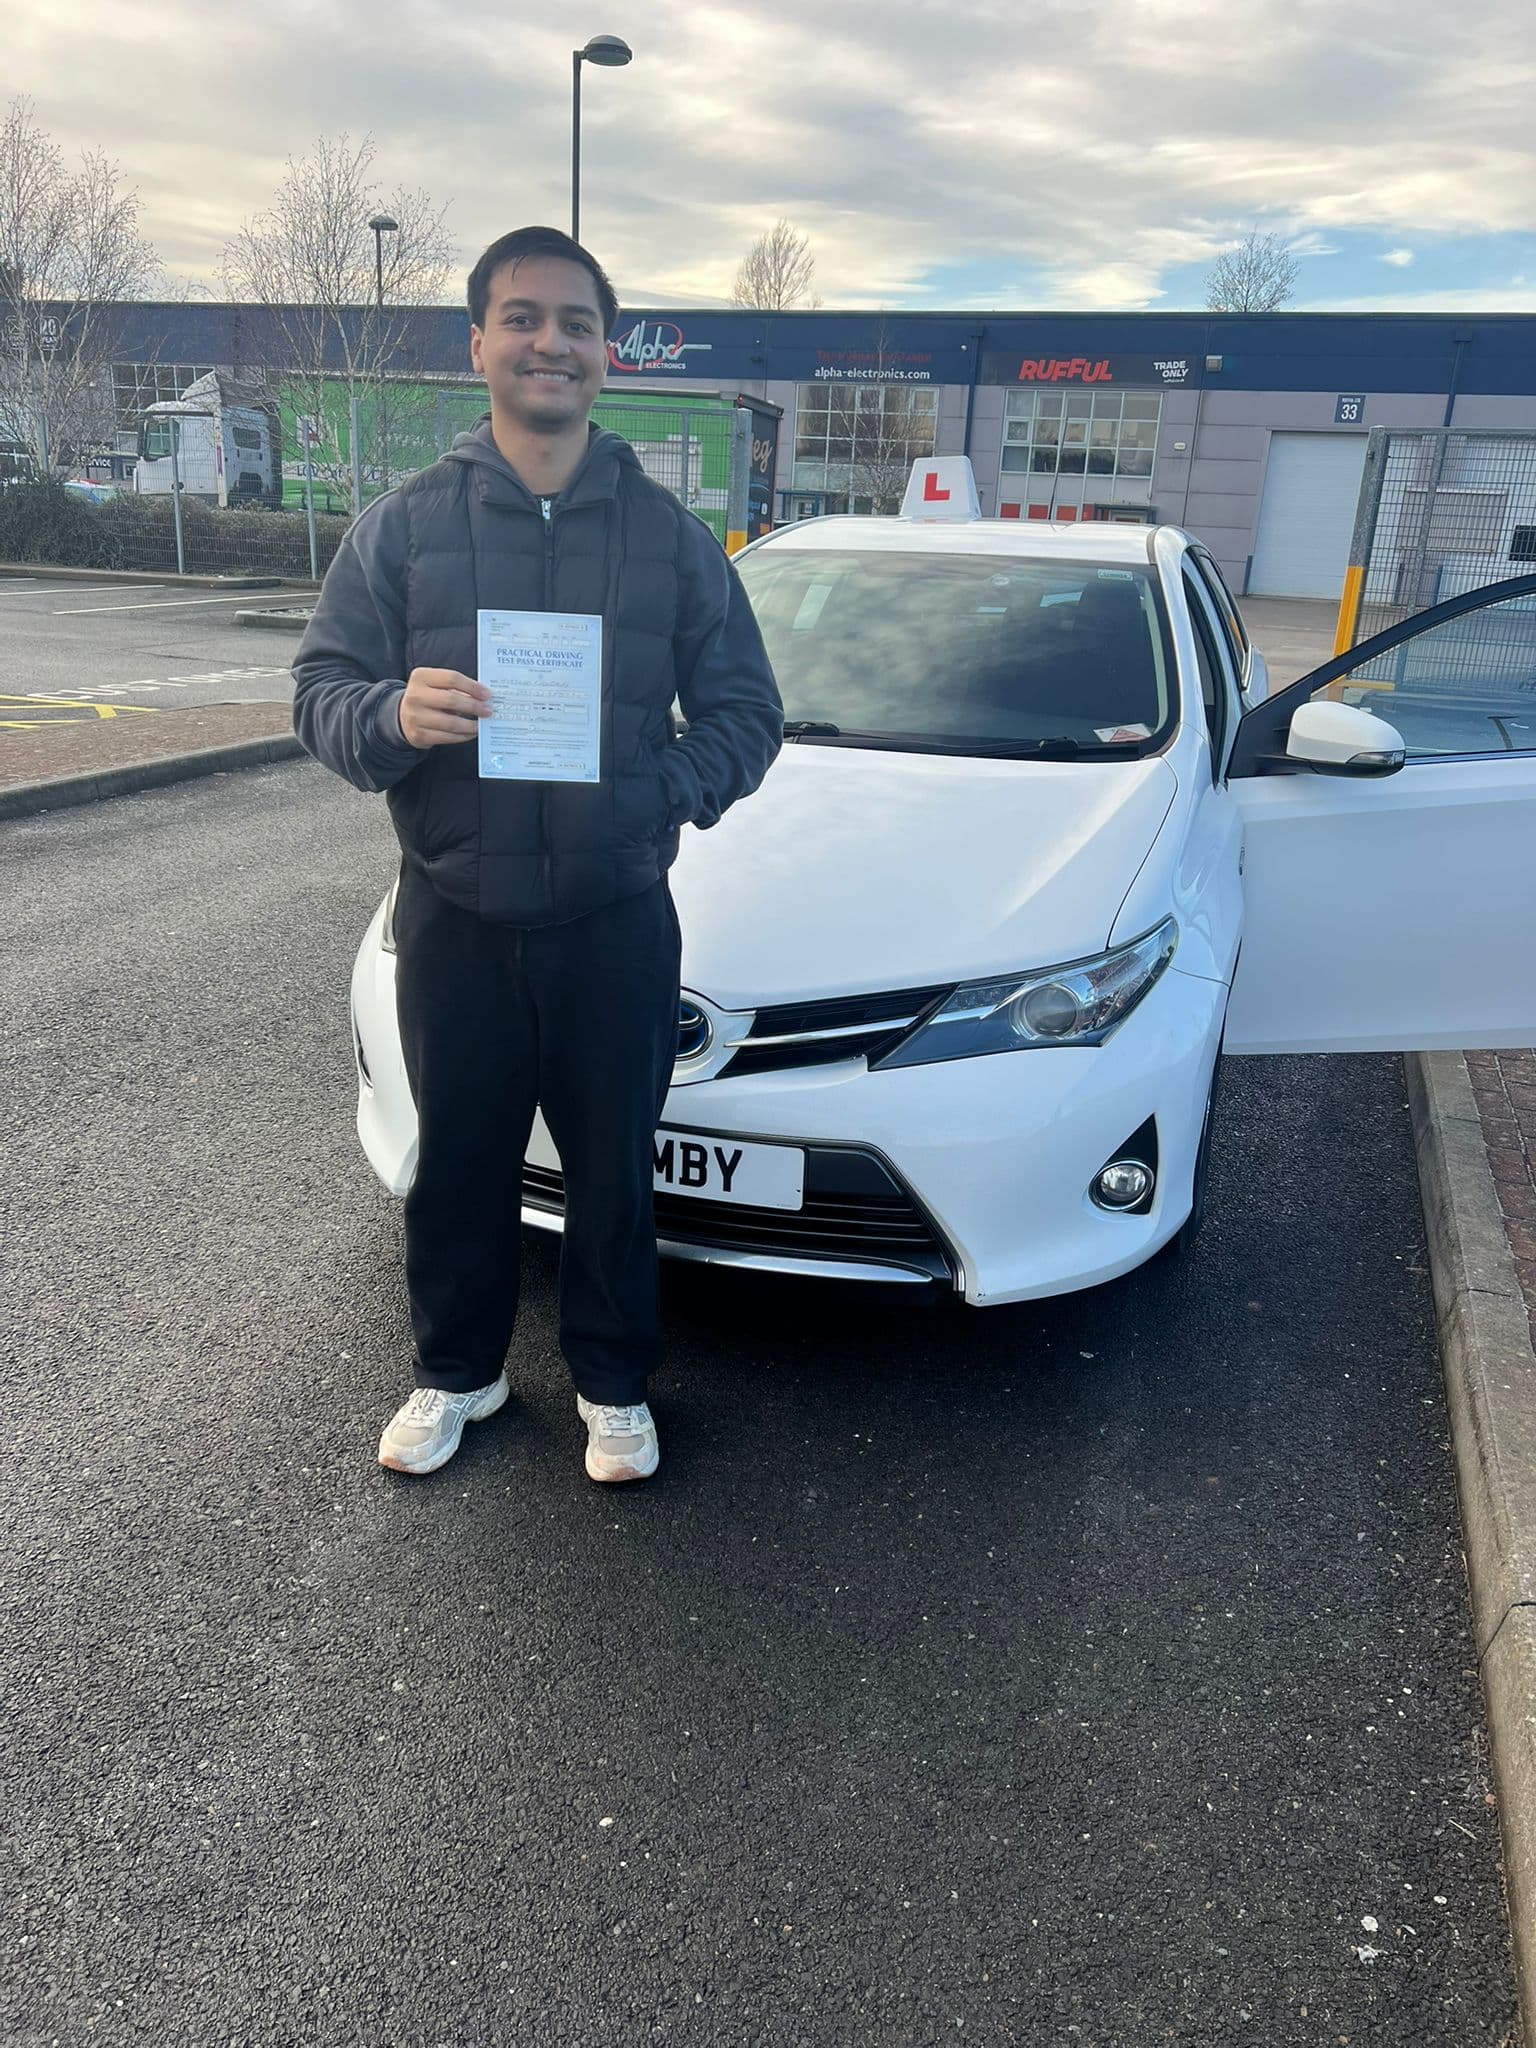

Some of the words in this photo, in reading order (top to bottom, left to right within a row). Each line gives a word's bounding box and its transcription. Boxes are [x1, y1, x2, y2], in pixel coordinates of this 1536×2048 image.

[608, 320, 702, 371] Alpha
[645, 362, 687, 370] ELECTRONICS
[1018, 358, 1113, 383] RUFFUL
[1153, 360, 1186, 370] TRADE
[814, 366, 930, 380] alpha-electronics.com
[1162, 368, 1189, 378] ONLY
[1341, 404, 1358, 420] 33
[924, 472, 950, 501] L
[496, 647, 543, 658] PRACTICAL
[545, 650, 584, 660] DRIVING
[497, 656, 514, 665] TEST
[516, 657, 535, 666] PASS
[536, 658, 584, 669] CERTIFICATE
